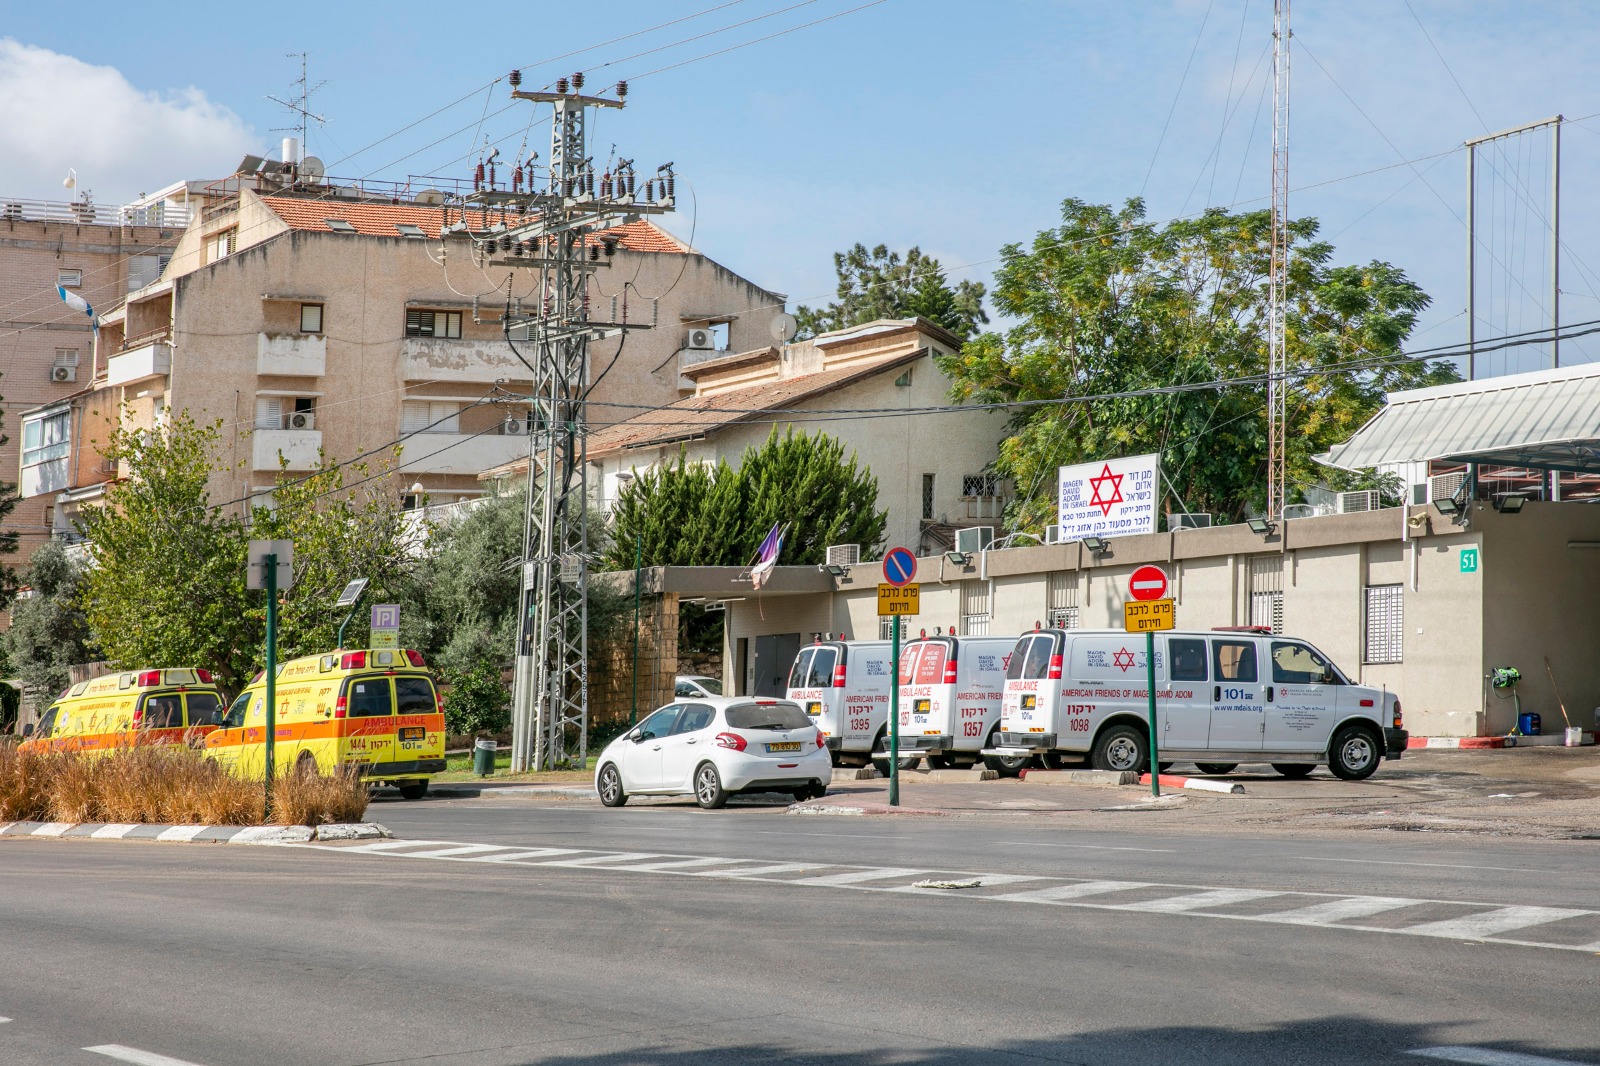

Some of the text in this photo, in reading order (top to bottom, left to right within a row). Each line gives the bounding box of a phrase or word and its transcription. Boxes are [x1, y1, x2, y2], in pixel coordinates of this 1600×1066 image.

[1128, 470, 1152, 481] מגן דוד
[1063, 480, 1083, 488] MAGEN
[1136, 481, 1152, 491] אדום
[1063, 487, 1080, 495] DAVID
[1063, 494, 1080, 502] ADOM
[1126, 491, 1151, 502] בישראל
[1063, 500, 1088, 510] IN ISRAEL
[1120, 504, 1151, 515] מרחב ירקון
[1087, 510, 1102, 518] תחנת
[1109, 519, 1132, 529] מסעוד
[1134, 514, 1151, 525] לזכר
[1093, 522, 1106, 532] כהן
[1462, 553, 1475, 568] 51
[881, 587, 900, 598] לרכב
[889, 602, 909, 612] חירום
[1128, 604, 1170, 615] פרט לרכב
[1138, 618, 1161, 629] חירום
[1009, 681, 1039, 691] AMBULANCE
[791, 690, 822, 700] AMBULANCE
[899, 687, 931, 697] MBULANCE
[957, 692, 986, 700] AMERICAN
[987, 692, 1003, 700] FRIEN
[1061, 689, 1193, 699] AMERICAN FRIENDS OF MAGE DAVID ADOM
[1224, 688, 1244, 700] 101
[846, 695, 889, 703] AMERICAN FRIEN
[849, 705, 874, 716] ירקון
[961, 707, 987, 718] ירקון
[1067, 704, 1096, 715] ירקון
[1214, 705, 1263, 713] www.mdais.org
[363, 716, 426, 728] AMBULANCE
[914, 715, 923, 723] 101
[850, 719, 870, 731] 1395
[963, 722, 983, 737] 1357
[1070, 719, 1089, 732] 1098
[350, 738, 366, 751] 1444
[370, 740, 391, 750] ירקון
[401, 742, 416, 750] 101
